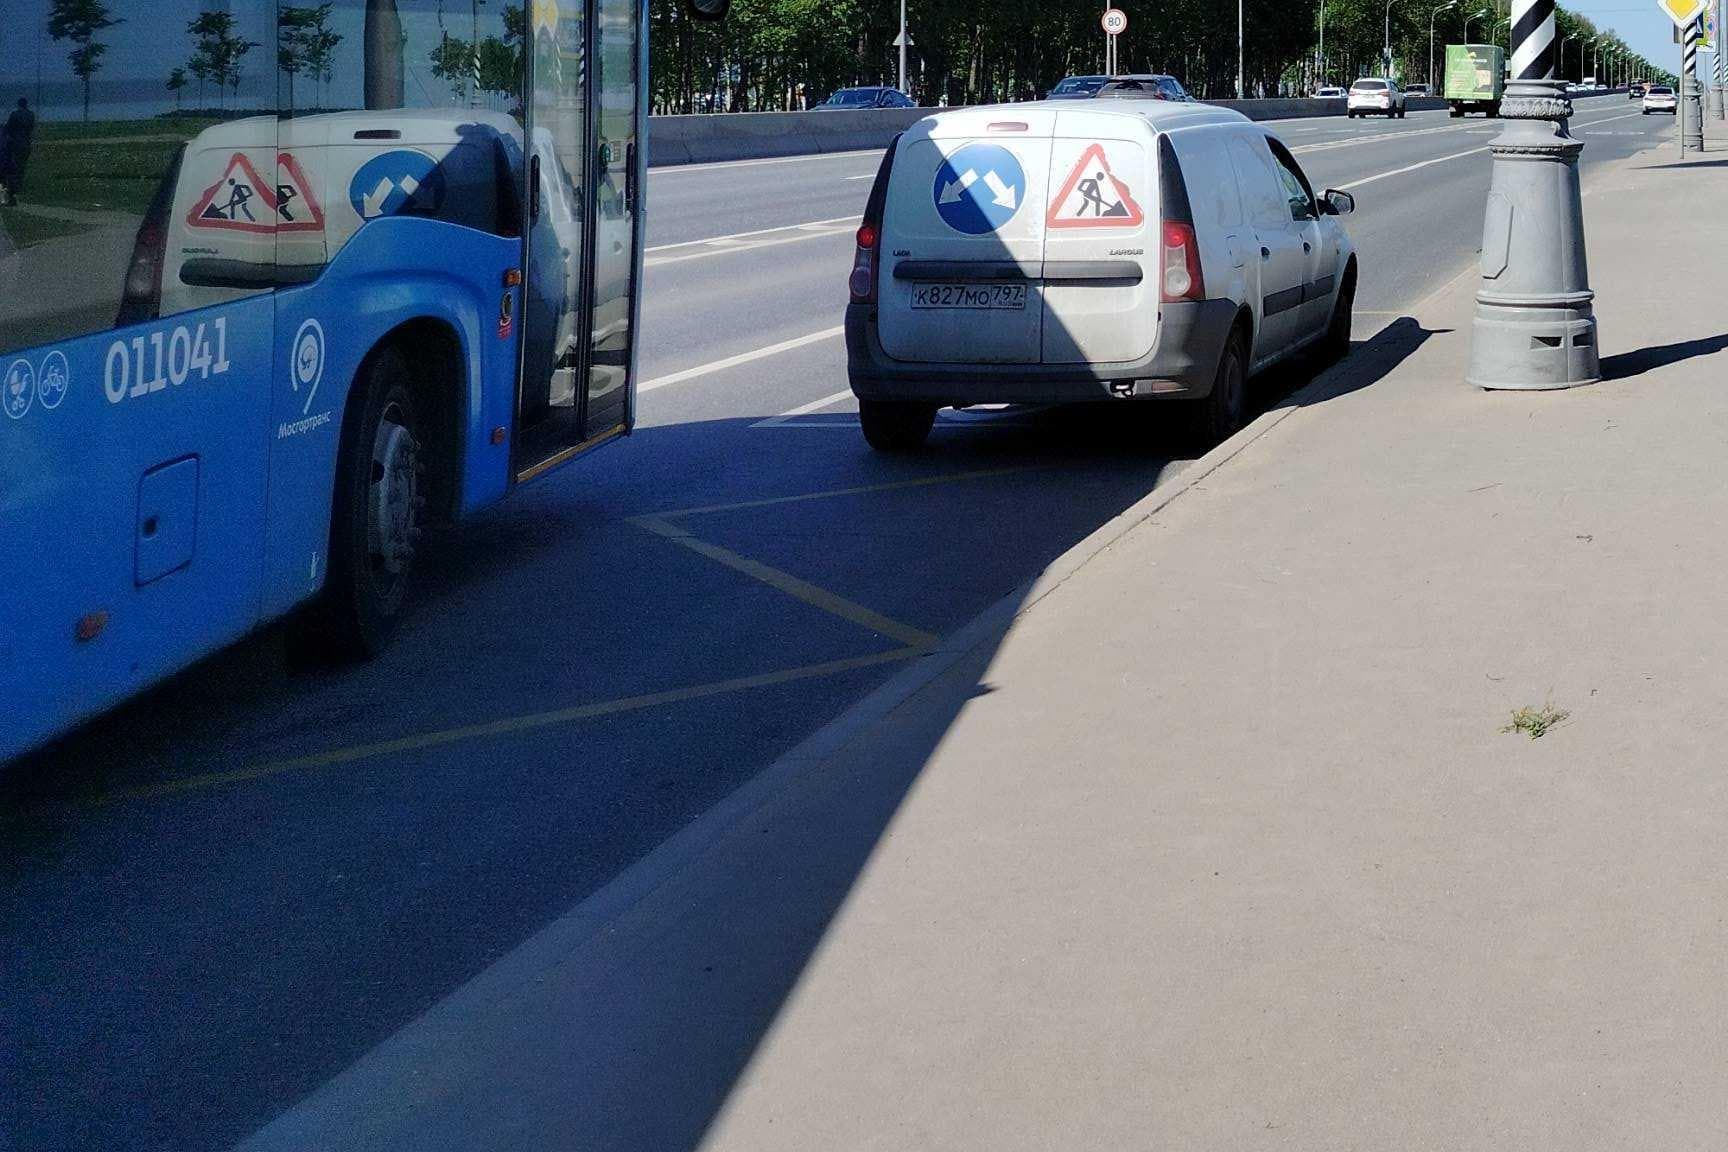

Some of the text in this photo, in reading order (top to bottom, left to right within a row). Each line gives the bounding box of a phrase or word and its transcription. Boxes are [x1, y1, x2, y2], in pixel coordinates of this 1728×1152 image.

[1107, 16, 1121, 27] 80
[991, 285, 1021, 302] 797
[104, 316, 230, 404] 011041
